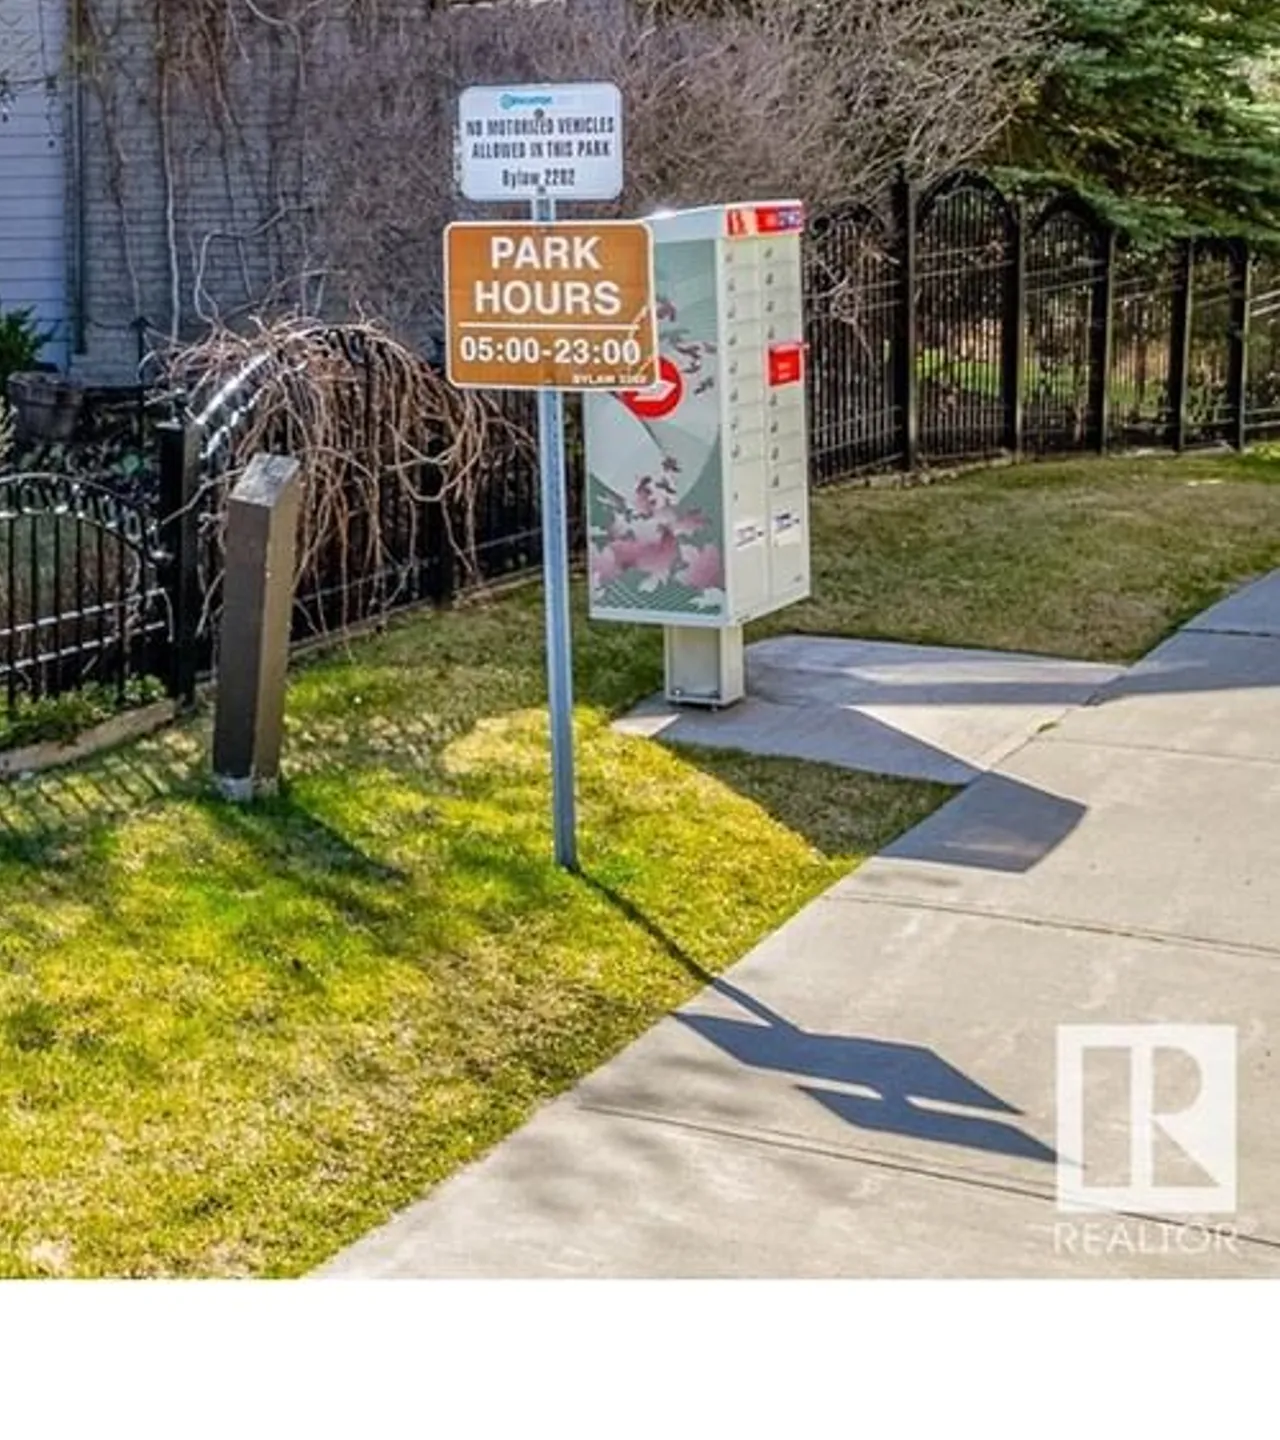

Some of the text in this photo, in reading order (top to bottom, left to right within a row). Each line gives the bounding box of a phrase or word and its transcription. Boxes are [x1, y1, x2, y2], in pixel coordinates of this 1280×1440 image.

[466, 117, 614, 136] NO MOTORIZED VEHICLES
[472, 140, 610, 158] ALLOWED IN THIS PARK
[502, 169, 539, 189] Bylaw
[491, 236, 603, 270] PARK
[474, 280, 622, 315] HOURS
[460, 336, 641, 365] 05:00-23:00
